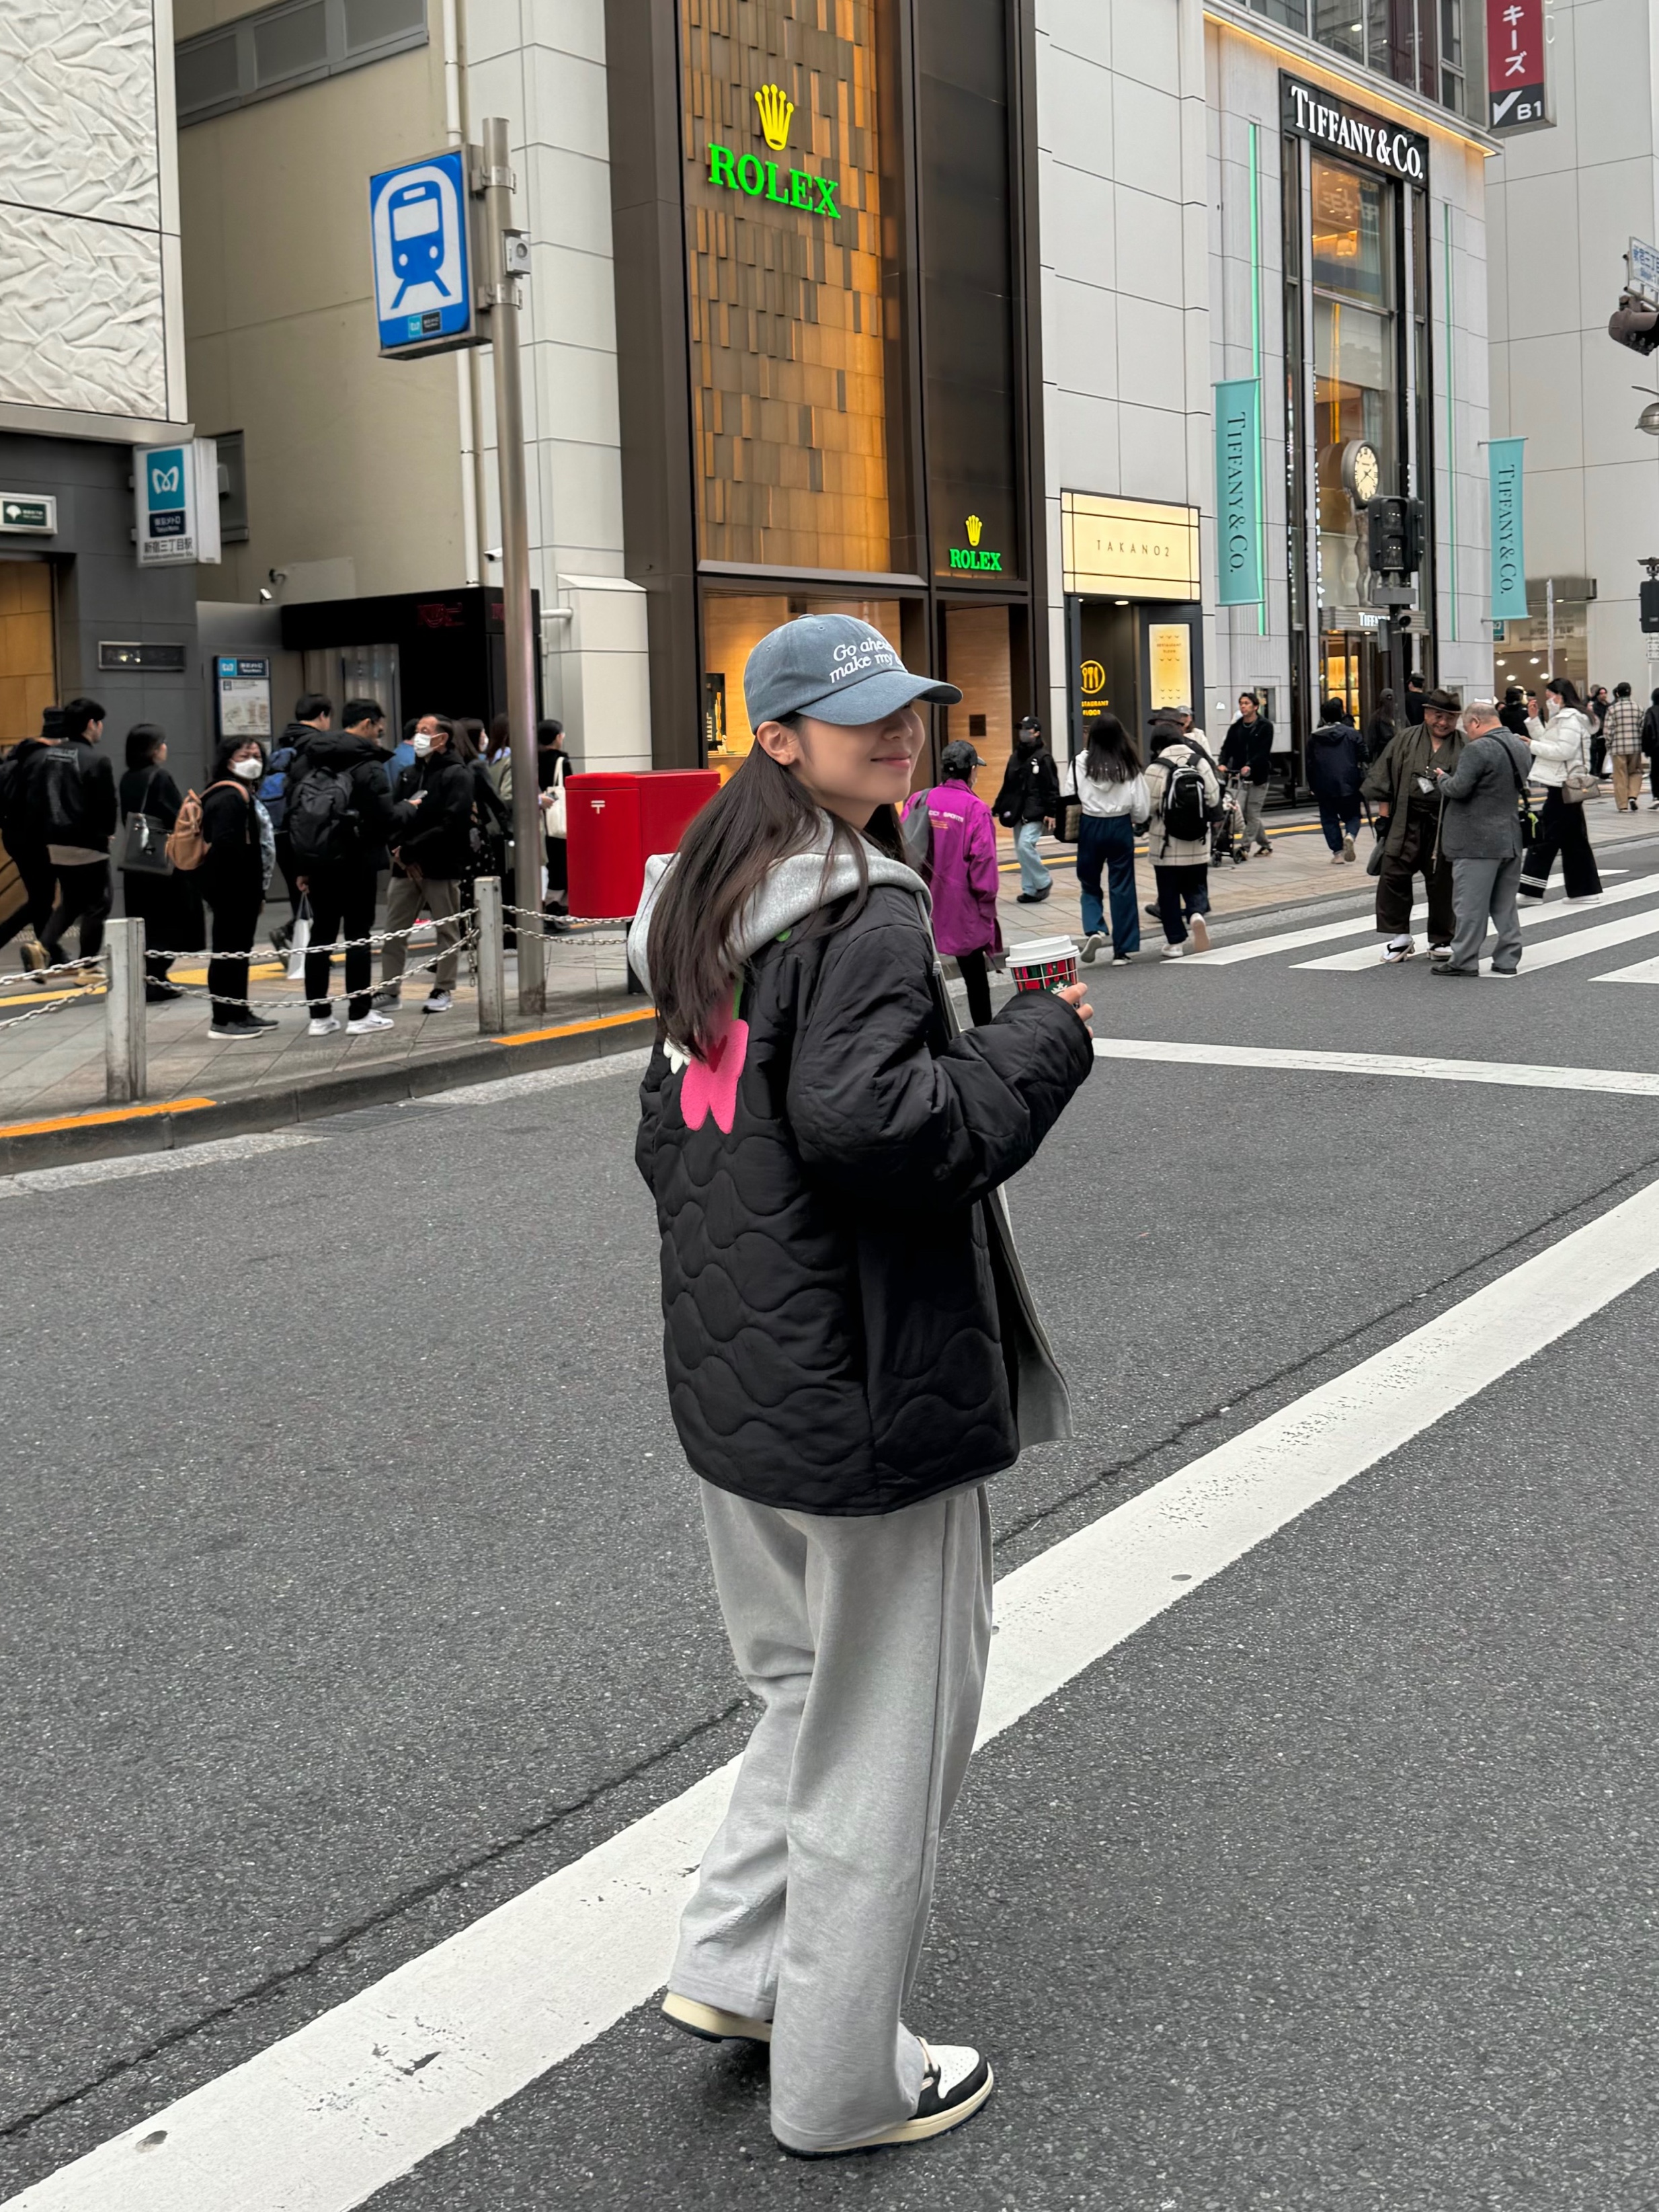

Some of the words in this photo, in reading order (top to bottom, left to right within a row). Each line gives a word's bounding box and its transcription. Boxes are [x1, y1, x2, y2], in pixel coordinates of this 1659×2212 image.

[1517, 101, 1541, 120] B1
[708, 143, 841, 219] ROLEX
[1097, 539, 1169, 557] TAKANO2
[949, 549, 1002, 571] ROLEX
[833, 644, 856, 662] Go
[830, 656, 872, 684] make
[875, 654, 893, 666] my
